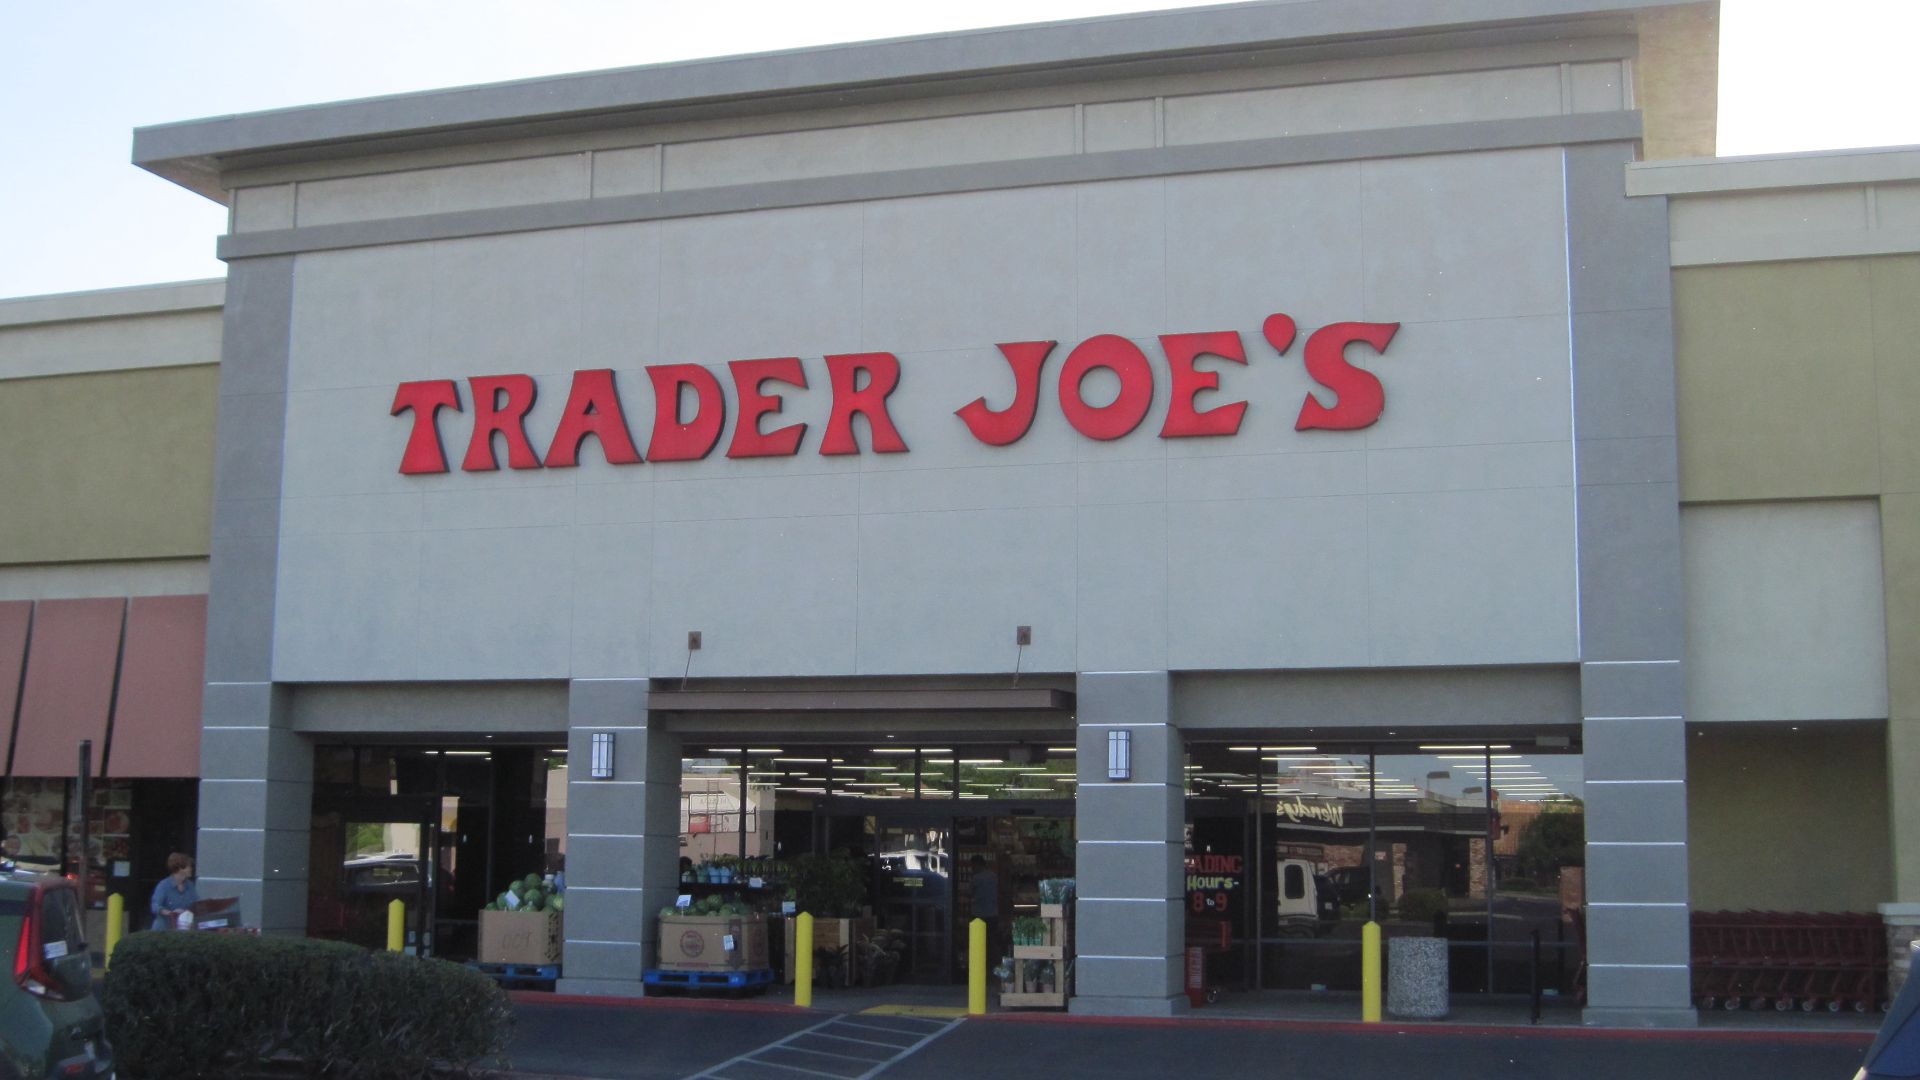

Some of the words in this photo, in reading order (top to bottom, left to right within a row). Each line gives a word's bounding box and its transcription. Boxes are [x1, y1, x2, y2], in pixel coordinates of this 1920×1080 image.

[390, 352, 910, 475] TRADER
[953, 313, 1400, 447] JOE'S
[1193, 892, 1204, 912] 8
[1216, 892, 1228, 912] 9
